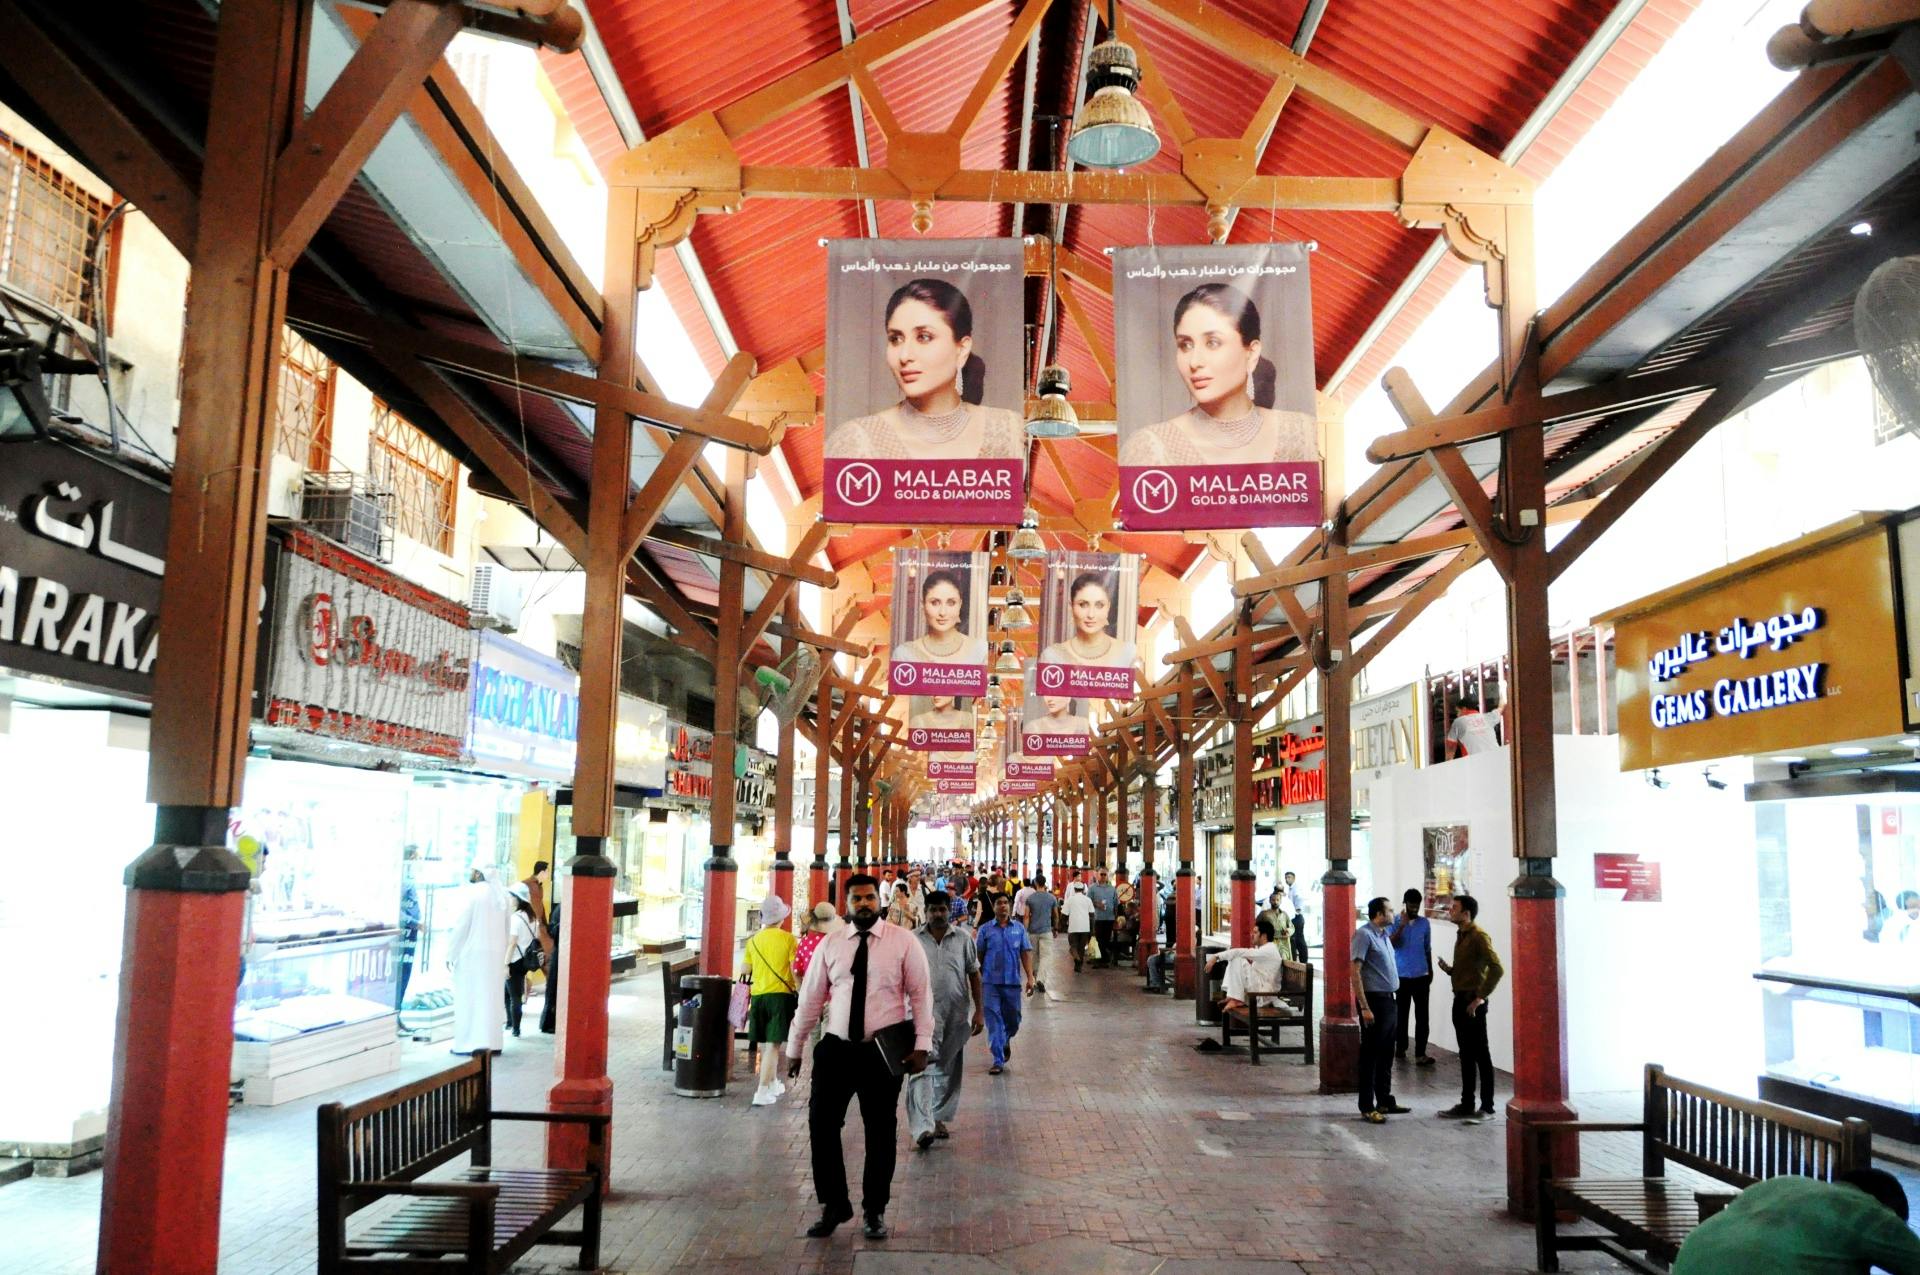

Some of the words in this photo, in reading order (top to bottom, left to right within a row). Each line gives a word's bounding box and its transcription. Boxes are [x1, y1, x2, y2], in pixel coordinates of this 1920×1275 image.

[882, 262, 911, 272] ذهب
[942, 261, 959, 272] من
[960, 261, 1011, 272] مجوهرات
[1168, 266, 1197, 278] ذهب
[1228, 265, 1245, 276] من
[1246, 265, 1297, 276] مجوهرات
[893, 469, 1012, 488] MALABAR
[1189, 472, 1308, 493] MALABAR
[894, 489, 930, 501] GOLD
[932, 489, 941, 501] &
[943, 489, 1012, 501] DIAMONDS
[1191, 495, 1228, 506] GOLD
[1229, 494, 1238, 506] &
[1240, 492, 1309, 504] DIAMONDS
[1715, 606, 1817, 659] مجوهرات
[1649, 630, 1708, 682] غاليري
[922, 667, 982, 679] MALABAR
[1070, 670, 1129, 682] MALABAR
[1094, 681, 1129, 689] DIAMONDS
[1651, 689, 1706, 728] GEMS
[1713, 662, 1819, 716] GALLERY
[1826, 685, 1842, 697] LLC
[931, 731, 971, 739] MALABAR
